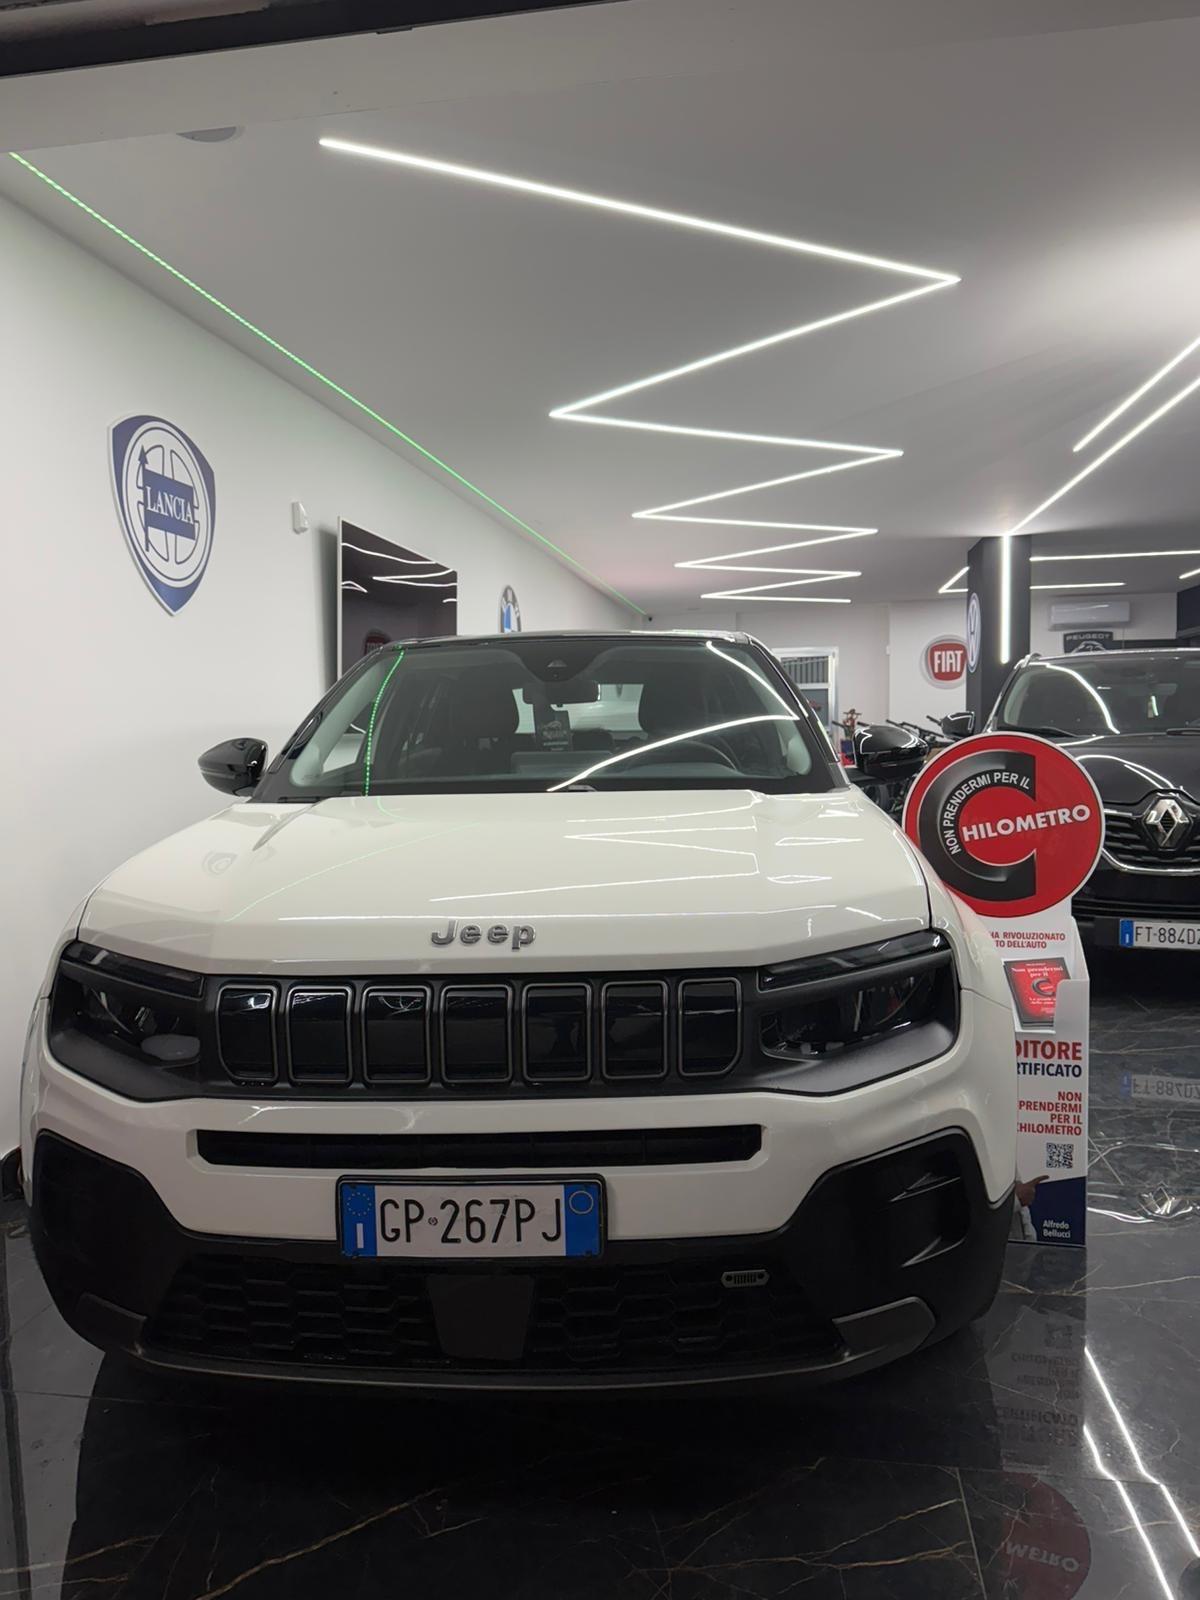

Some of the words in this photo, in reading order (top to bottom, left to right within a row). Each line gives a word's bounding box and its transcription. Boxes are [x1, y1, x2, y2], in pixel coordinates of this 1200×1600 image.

[146, 485, 194, 524] LANCIA
[934, 650, 964, 673] FIAT
[994, 772, 1018, 784] PER
[1020, 776, 1030, 790] IL
[943, 774, 991, 827] PRENDERMI
[962, 804, 1091, 842] HILOMETRO
[946, 829, 962, 855] NON
[431, 919, 535, 950] Jeep
[1003, 931, 1066, 941] RIVOLUZIONATO
[1007, 940, 1047, 949] DELL'AUTO
[1058, 1091, 1082, 1101] NON
[1018, 1100, 1082, 1113] PRENDERMI
[1050, 1114, 1070, 1124] PER
[1073, 1115, 1083, 1125] IL
[1017, 1122, 1082, 1136] HILOMETRO
[1043, 1220, 1069, 1230] Alfredo
[1043, 1229, 1071, 1239] Bellucci
